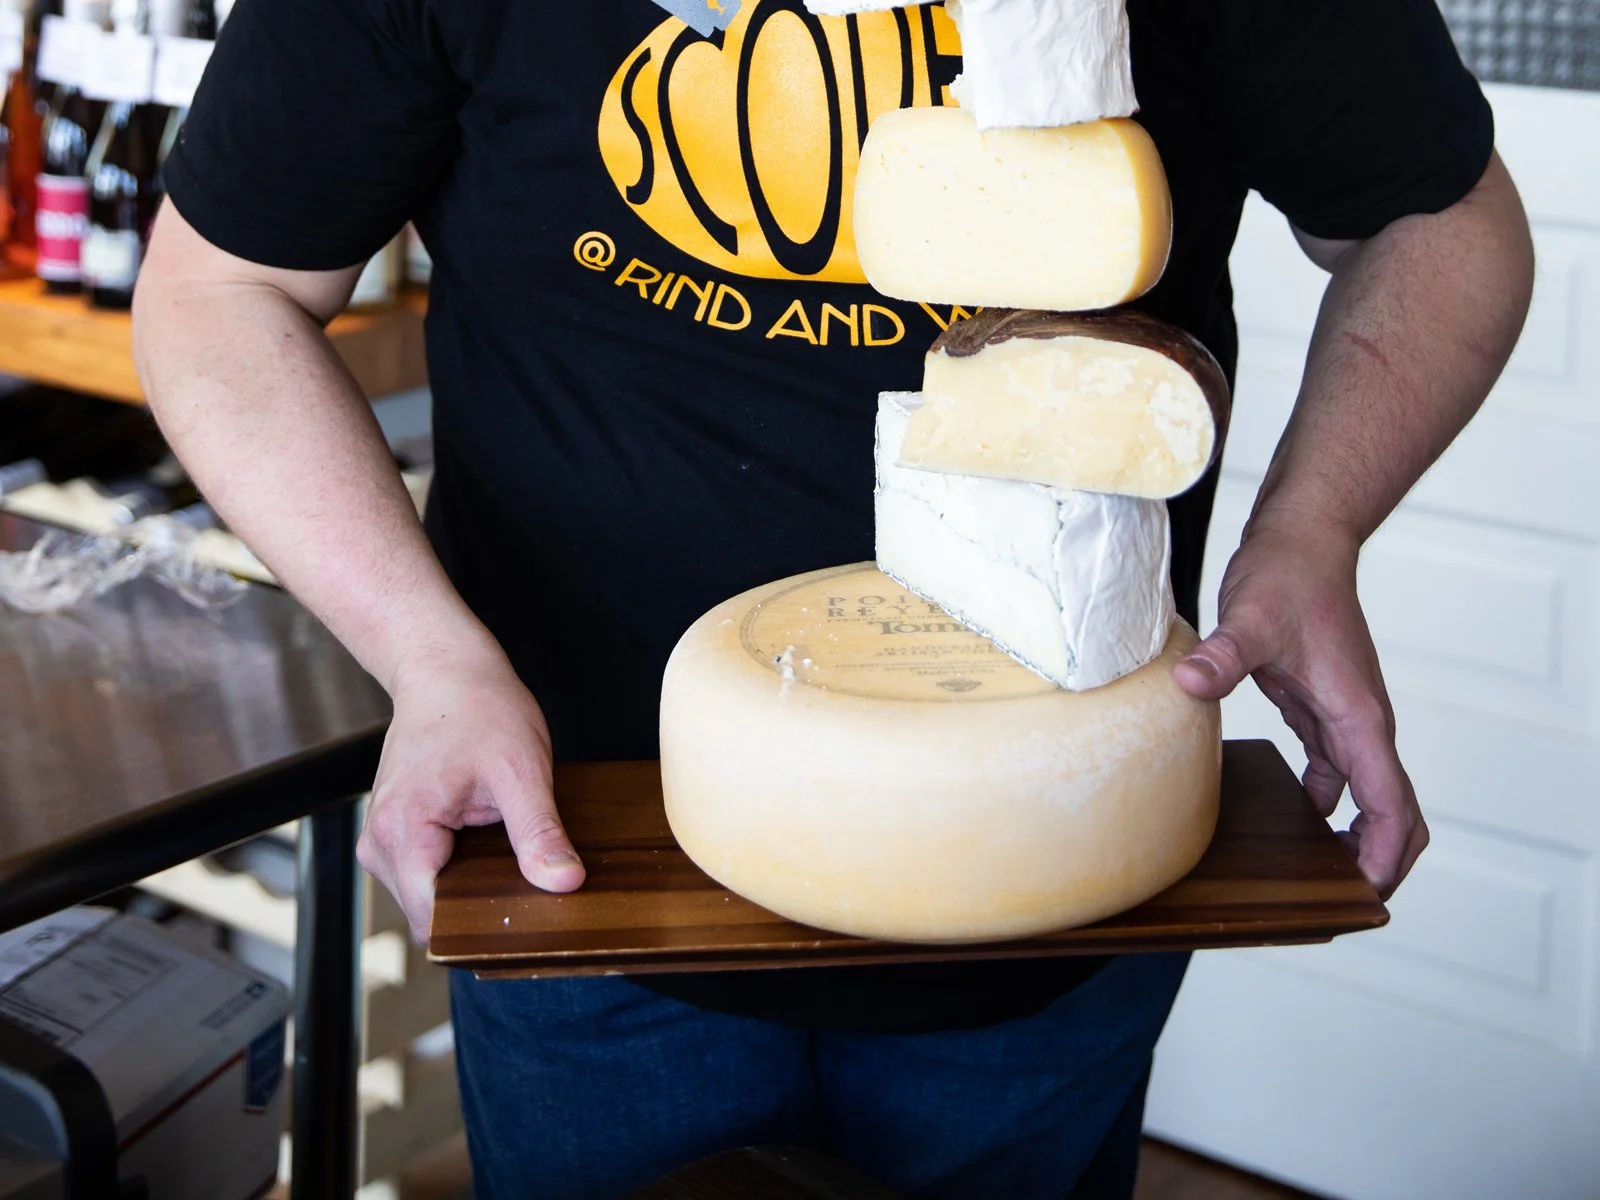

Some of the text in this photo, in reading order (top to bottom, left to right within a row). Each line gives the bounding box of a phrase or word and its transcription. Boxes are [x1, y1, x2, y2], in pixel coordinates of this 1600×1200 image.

[573, 231, 616, 272] @
[614, 257, 752, 331] RIND
[765, 299, 905, 346] AND
[867, 619, 977, 635] Tom
